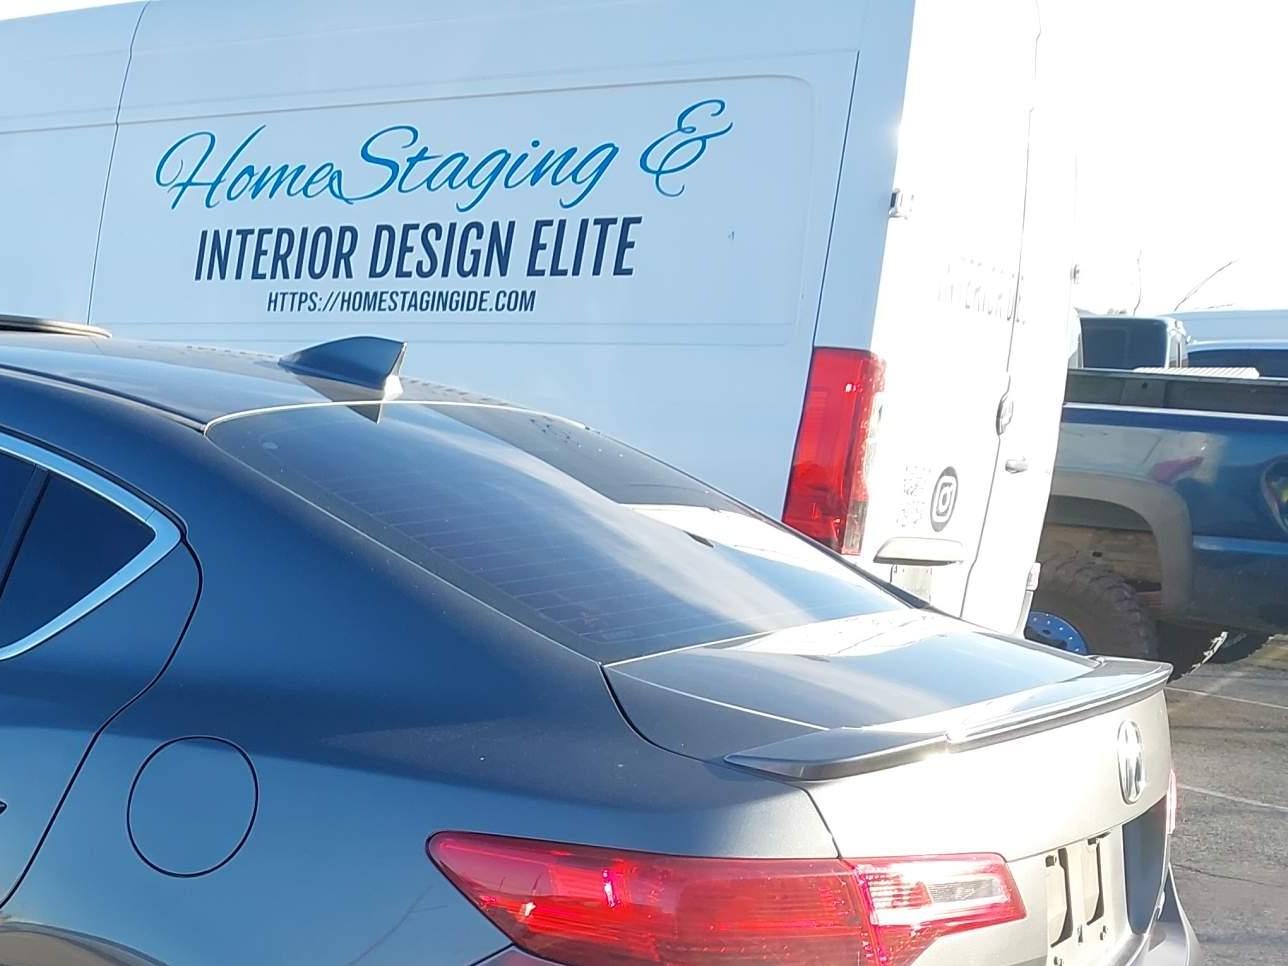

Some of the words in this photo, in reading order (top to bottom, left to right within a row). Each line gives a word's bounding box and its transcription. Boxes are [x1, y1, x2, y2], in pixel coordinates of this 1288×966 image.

[156, 125, 342, 210] Home
[329, 125, 619, 212] Staging
[639, 98, 734, 198] &
[194, 226, 358, 281] INTERIOR
[369, 220, 515, 279] DESIGN
[526, 215, 643, 278] ELITE
[266, 290, 537, 313] HTTPS://HOMESTAGINGIDE.COM
